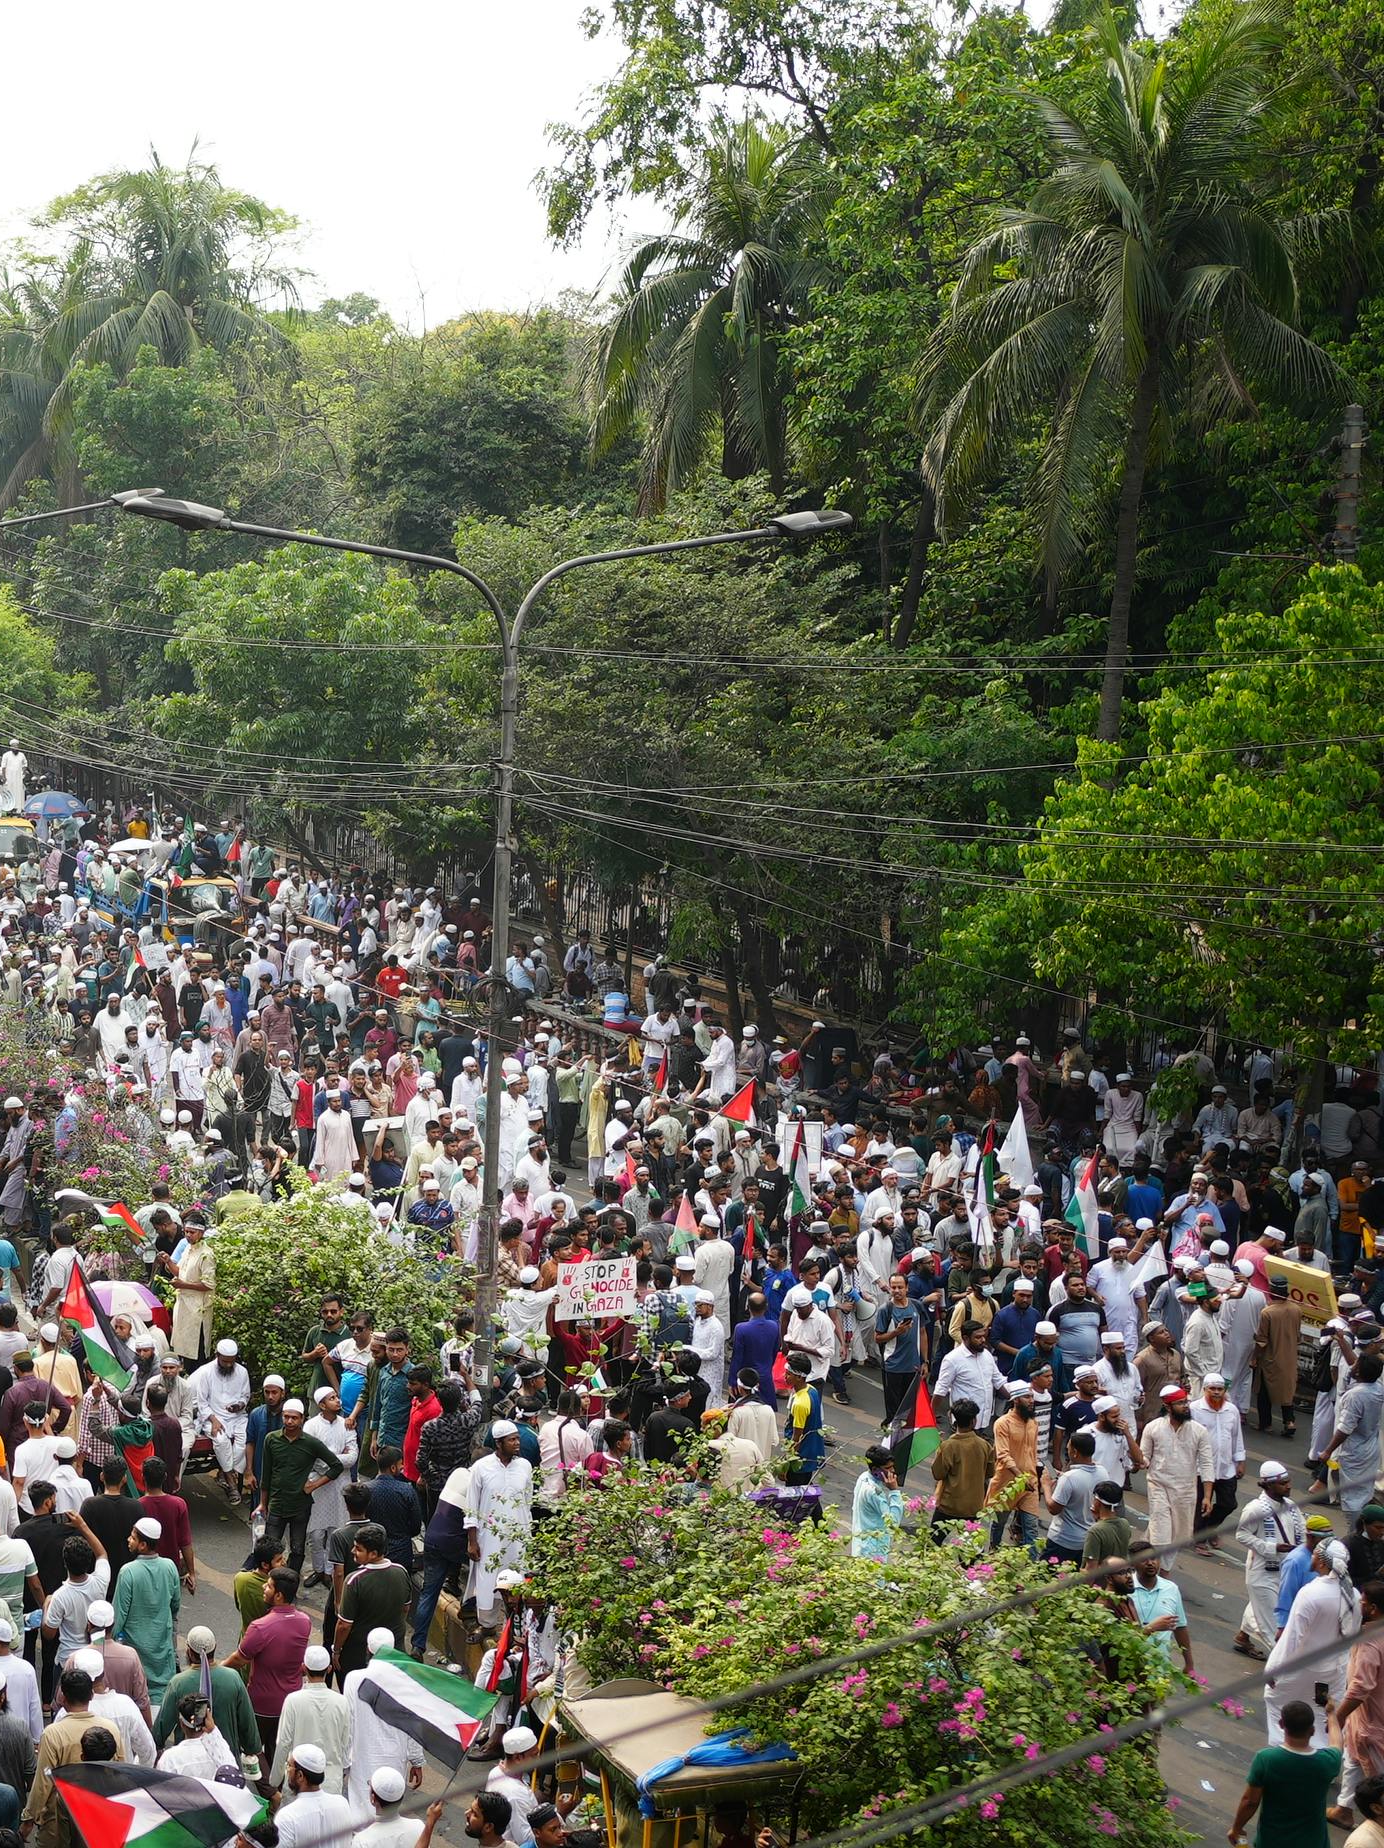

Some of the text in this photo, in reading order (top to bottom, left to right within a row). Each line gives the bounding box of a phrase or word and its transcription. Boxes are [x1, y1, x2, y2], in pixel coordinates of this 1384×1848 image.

[584, 1264, 616, 1280] STOP
[572, 1296, 624, 1315] IN GAZA
